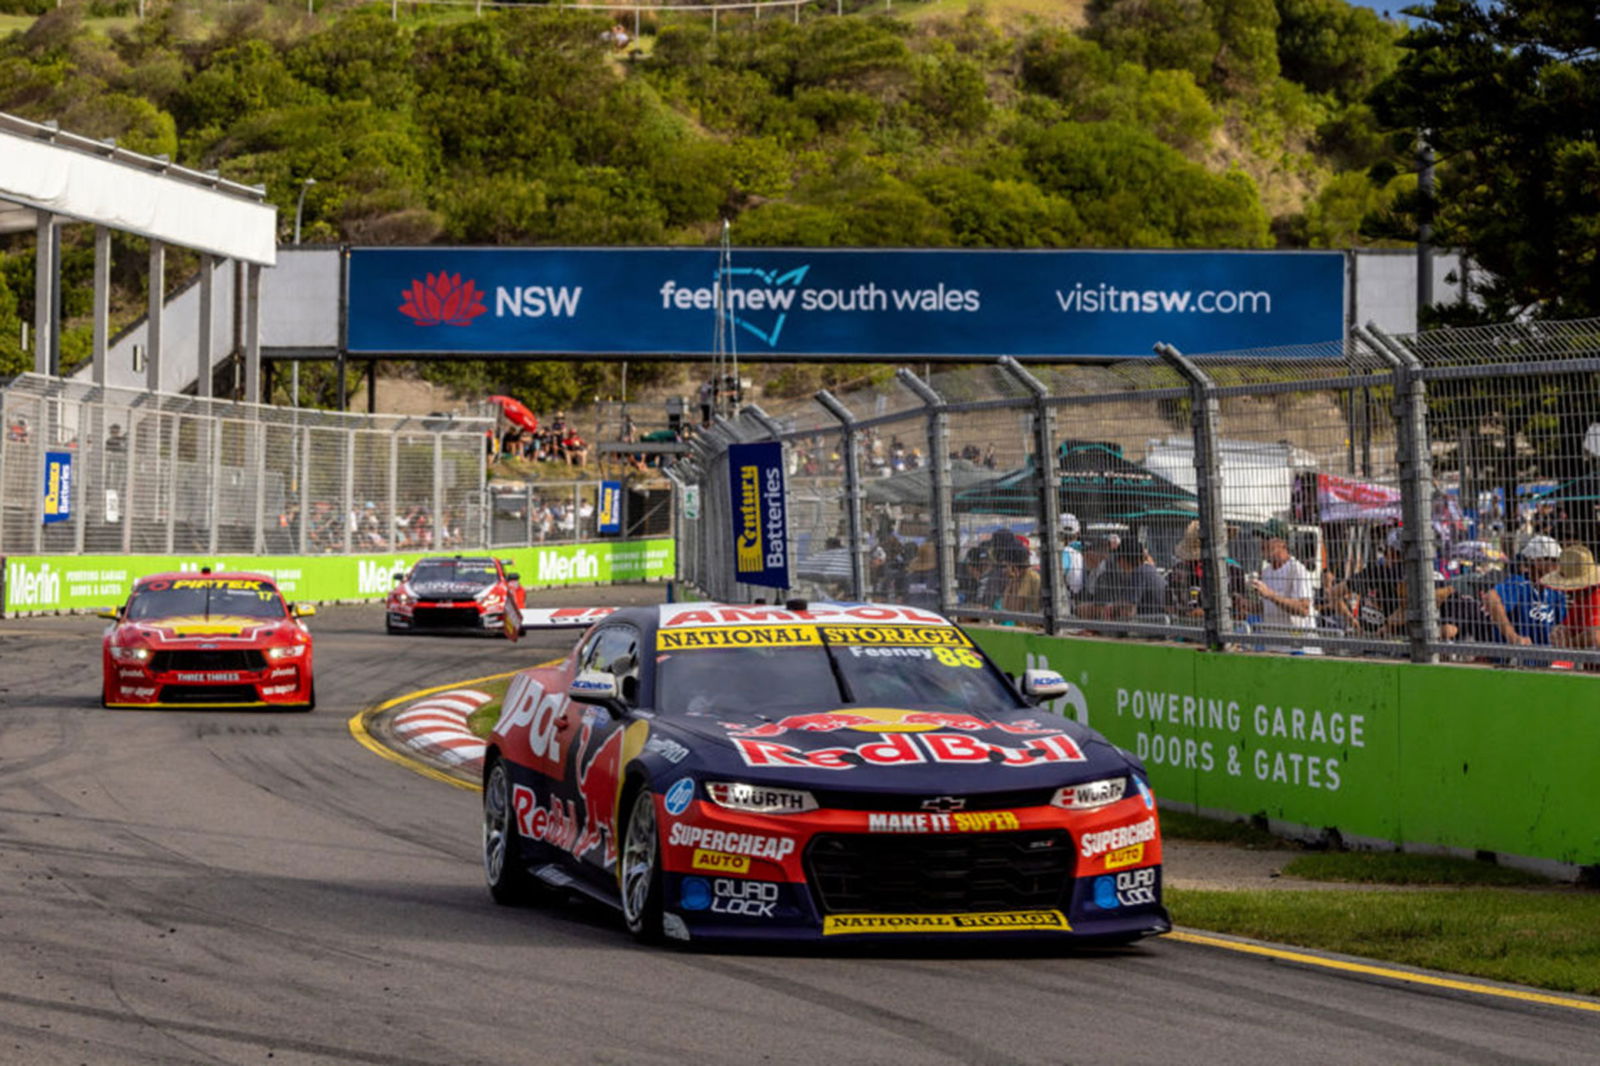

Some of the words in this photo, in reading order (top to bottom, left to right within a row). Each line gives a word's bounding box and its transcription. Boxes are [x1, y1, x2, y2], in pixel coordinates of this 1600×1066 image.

[495, 286, 582, 317] NSW
[660, 281, 719, 309] feel
[726, 289, 795, 309] new
[801, 284, 887, 311] south
[891, 282, 980, 311] wales
[1056, 282, 1271, 313] visitnsw.com
[765, 467, 784, 568] Batteries
[358, 559, 412, 593] Merl
[538, 550, 598, 580] Merlin
[9, 562, 60, 605] Merlin
[172, 579, 262, 591] PIRTEK
[257, 591, 273, 601] 17
[665, 607, 944, 626] AMPOL
[659, 628, 812, 648] NATIONAL
[824, 627, 960, 645] STORAGE
[849, 646, 933, 660] Feeney
[1117, 688, 1241, 732] POWERING
[1254, 704, 1366, 748] GARAGE
[1136, 732, 1215, 773] DOORS
[1226, 745, 1242, 777] &
[1254, 749, 1342, 792] GATES
[868, 813, 926, 833] MAKE
[931, 814, 950, 831] IT
[953, 812, 1020, 831] SUPER
[669, 822, 795, 861] SUPERCHEAP
[700, 853, 744, 868] AUTO
[1109, 848, 1139, 863] AUTO
[714, 878, 779, 901] QUAD
[1117, 868, 1155, 891] QUAD
[711, 898, 777, 918] LOCK
[834, 917, 951, 927] NATIONAL
